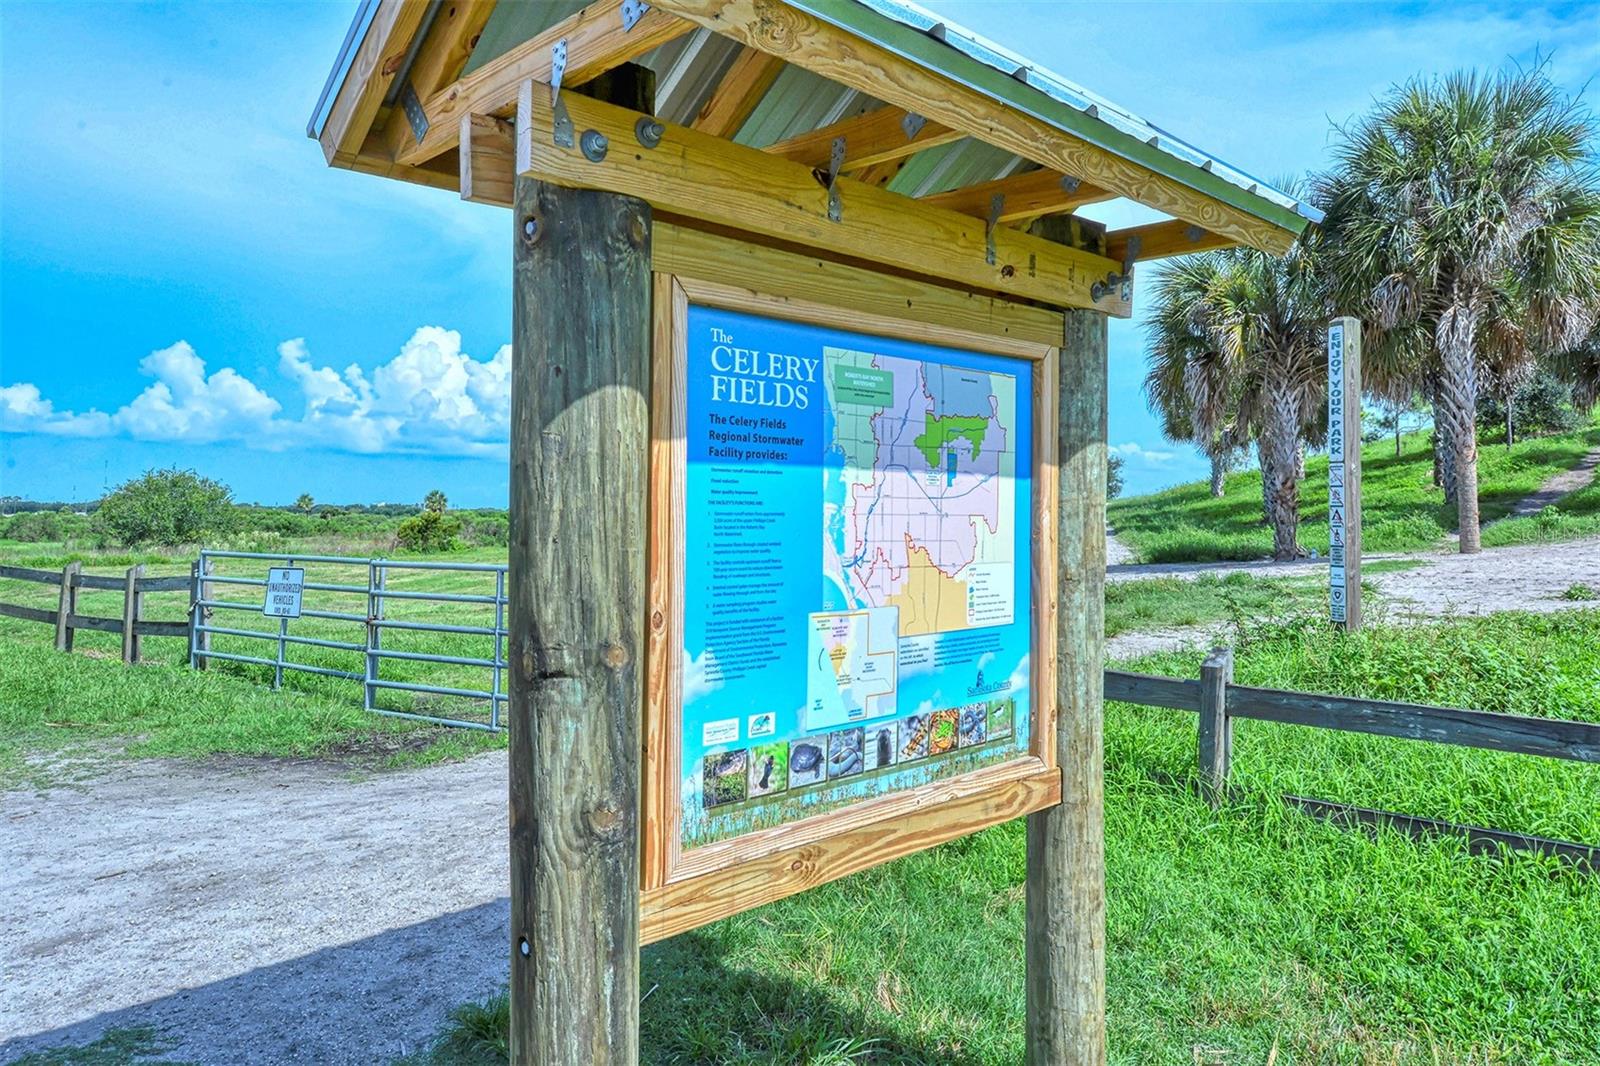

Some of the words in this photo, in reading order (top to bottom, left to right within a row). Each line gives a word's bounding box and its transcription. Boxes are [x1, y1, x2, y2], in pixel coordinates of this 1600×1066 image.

[710, 327, 733, 344] The
[1331, 332, 1342, 376] ENJOY
[711, 345, 820, 383] CELERY
[710, 374, 809, 410] FIELDS
[1331, 381, 1342, 416] YOUR
[709, 413, 727, 425] The
[729, 415, 758, 429] Celery
[760, 418, 787, 430] Fields
[709, 430, 751, 443] Regional
[753, 433, 804, 446] Stormwater
[1331, 420, 1342, 455] PARK
[708, 446, 744, 460] Facility
[745, 449, 788, 461] provides:
[282, 570, 290, 581] NO
[269, 583, 302, 593] UNAUTHORIZED
[273, 595, 294, 605] VEHICLES
